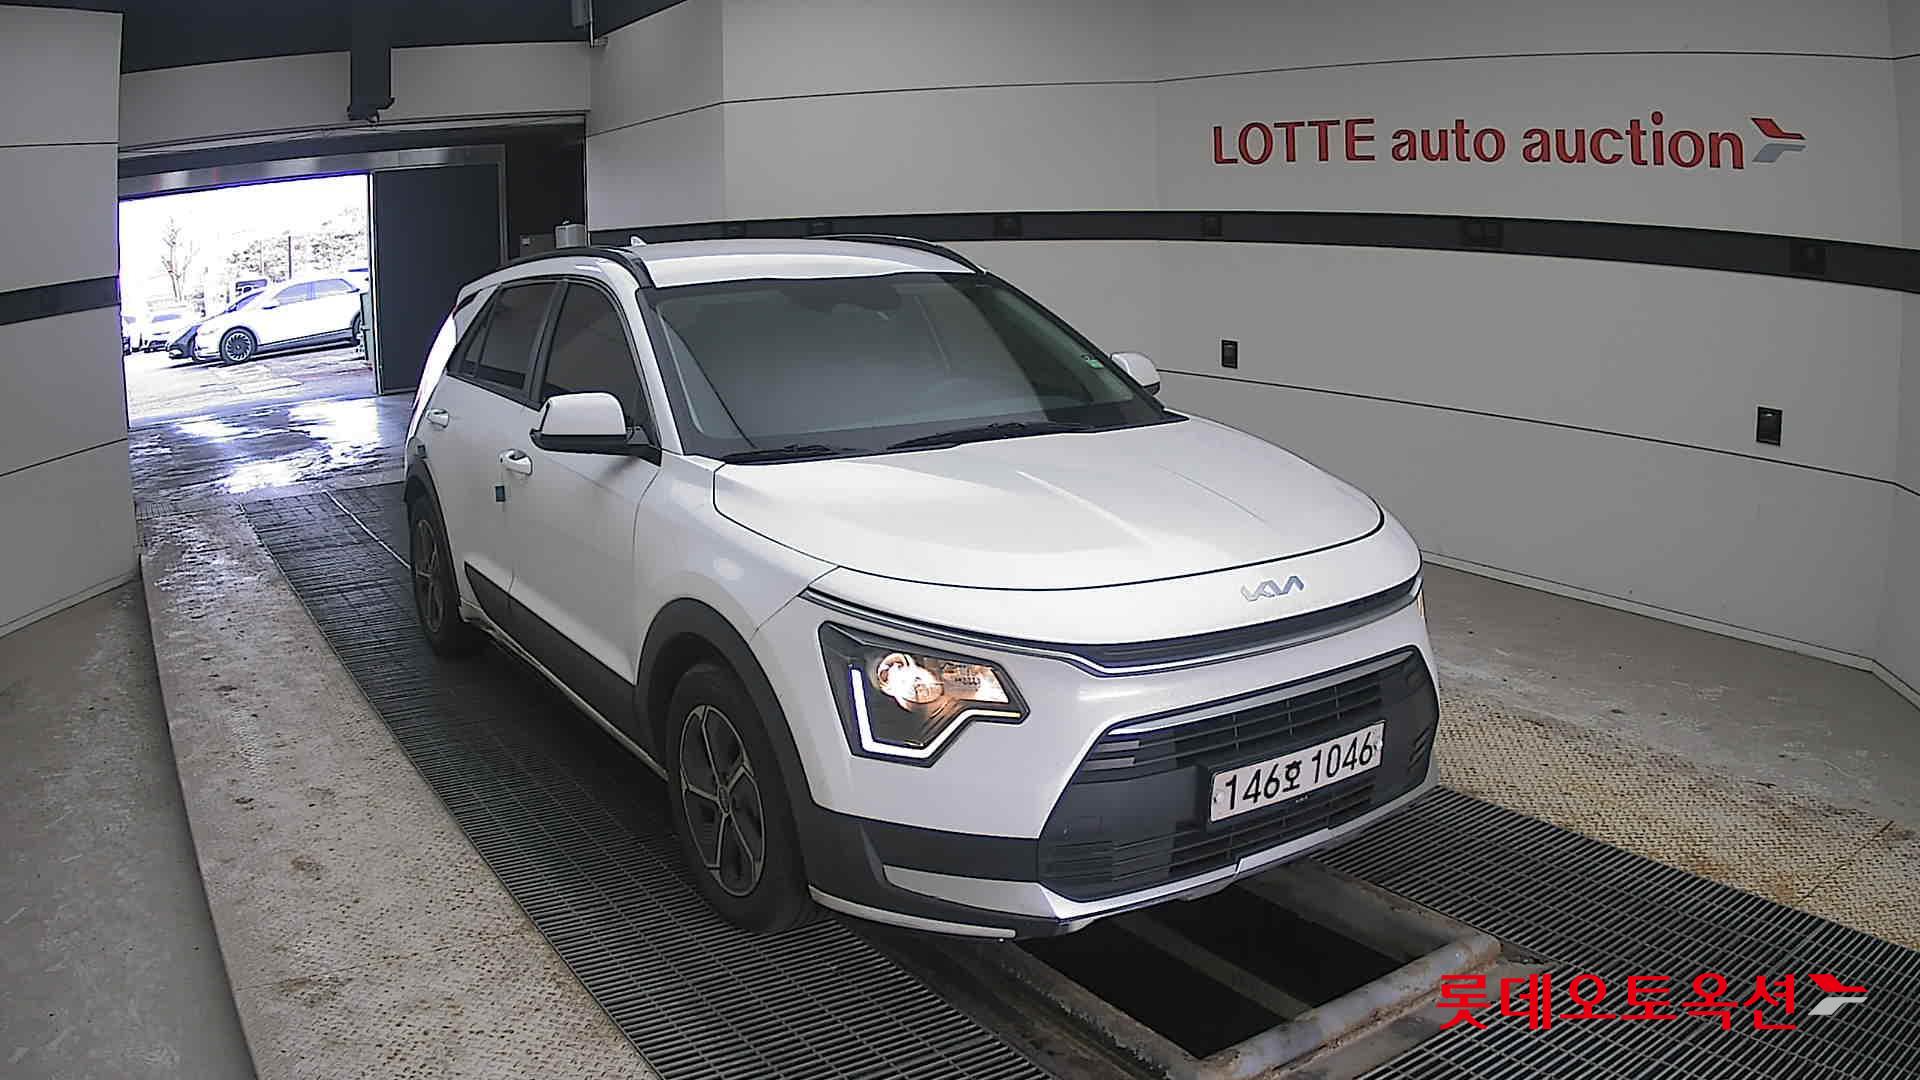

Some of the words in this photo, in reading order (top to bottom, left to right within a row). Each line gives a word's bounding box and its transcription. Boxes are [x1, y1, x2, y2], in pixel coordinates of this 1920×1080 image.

[1212, 118, 1376, 165] LOTTE
[1391, 119, 1505, 163] auto
[1522, 111, 1744, 170] auction
[1225, 760, 1303, 810] 146호
[1311, 731, 1373, 784] 1046
